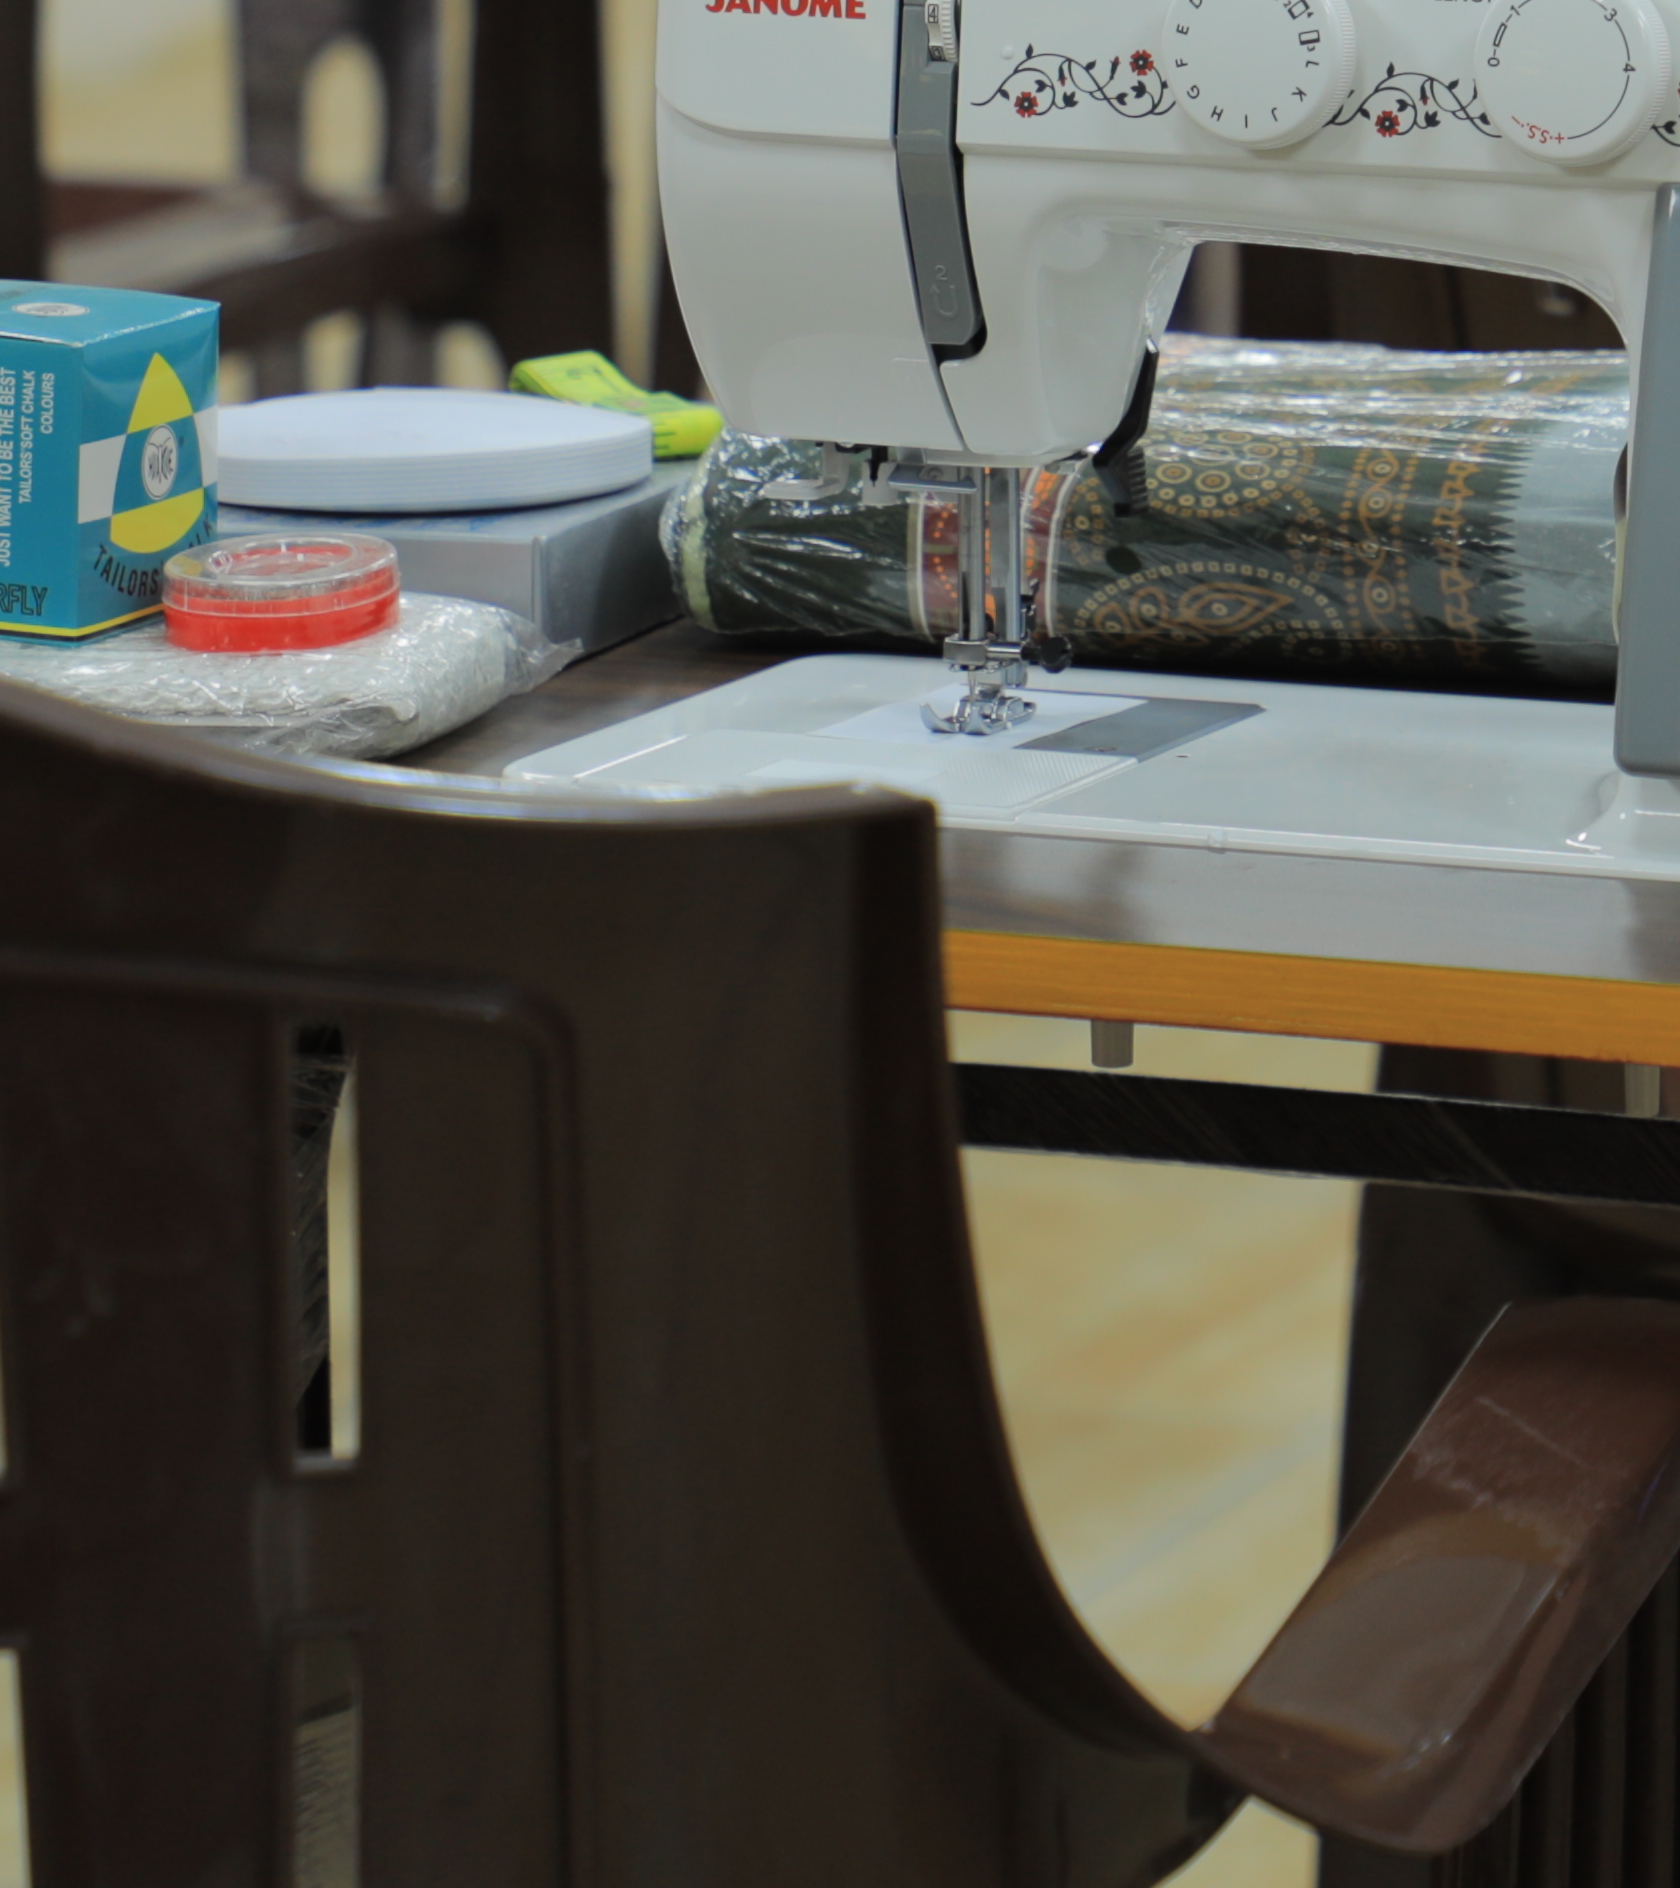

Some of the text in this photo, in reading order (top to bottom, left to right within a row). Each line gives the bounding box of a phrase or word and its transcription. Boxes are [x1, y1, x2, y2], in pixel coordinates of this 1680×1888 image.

[1176, 23, 1190, 35] E
[1487, 57, 1500, 67] 0
[1509, 4, 1521, 16] 1
[1603, 8, 1618, 22] 3
[1623, 63, 1636, 73] 4
[1175, 58, 1188, 68] F
[1305, 60, 1320, 68] L
[1187, 84, 1200, 99] G
[1291, 86, 1307, 102] K
[1210, 105, 1224, 122] H
[934, 264, 948, 281] 2
[21, 370, 36, 414] CHALK
[40, 372, 55, 434] COLOURS
